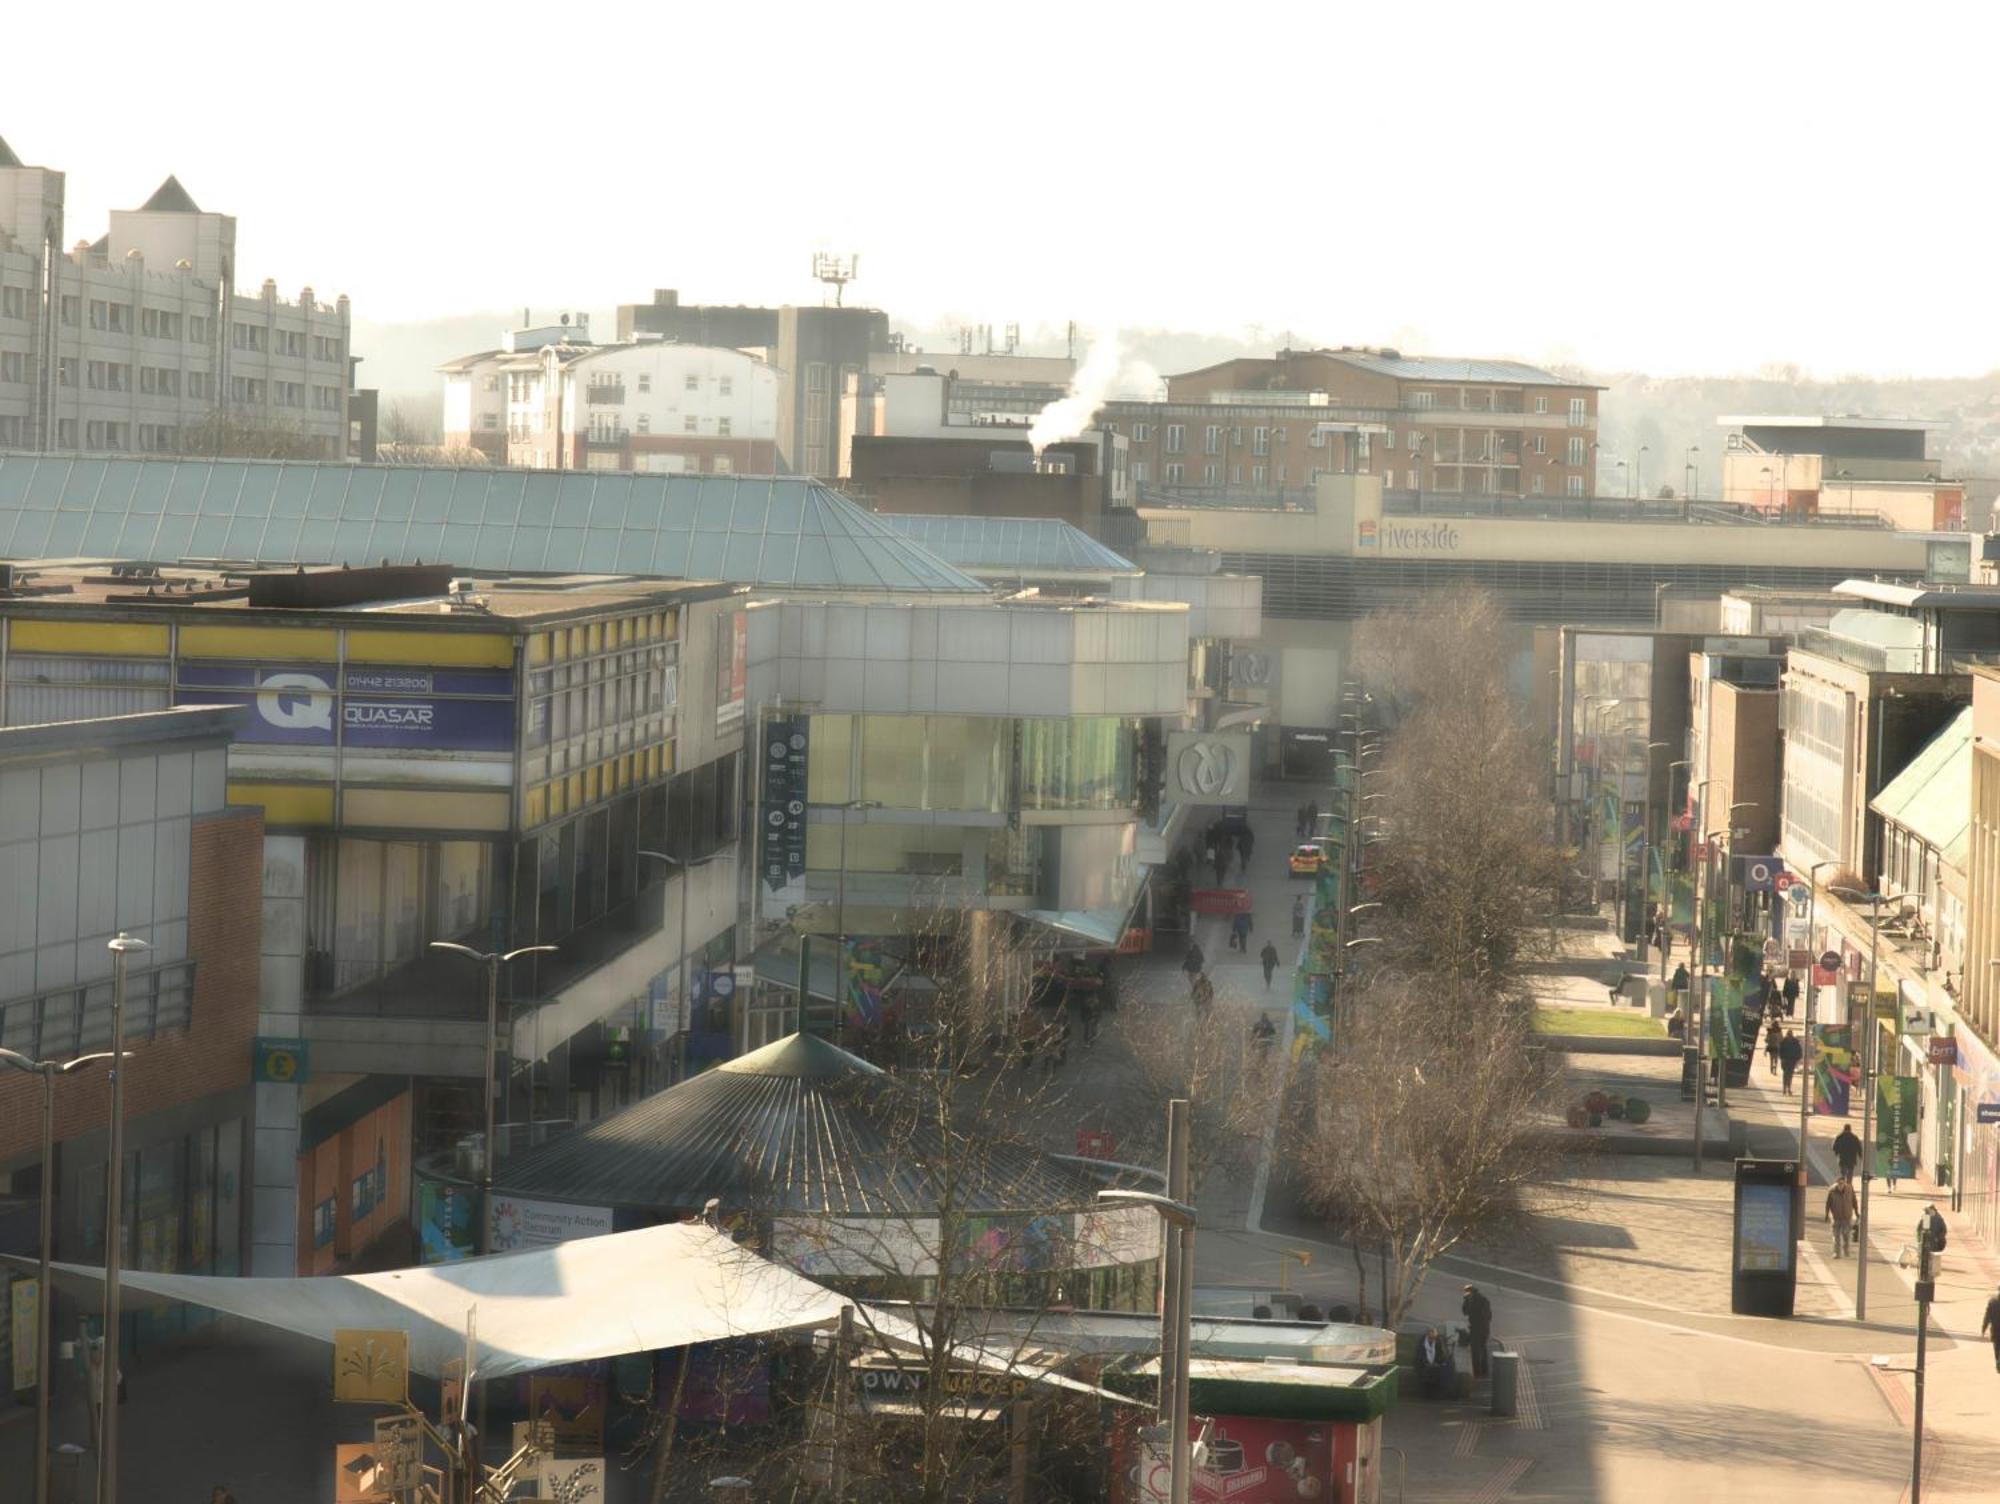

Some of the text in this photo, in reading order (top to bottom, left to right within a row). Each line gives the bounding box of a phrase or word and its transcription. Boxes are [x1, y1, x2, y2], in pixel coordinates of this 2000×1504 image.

[1380, 523, 1459, 549] riverside
[349, 676, 382, 688] 01442
[256, 673, 332, 730] Q
[343, 707, 433, 725] QUASAR
